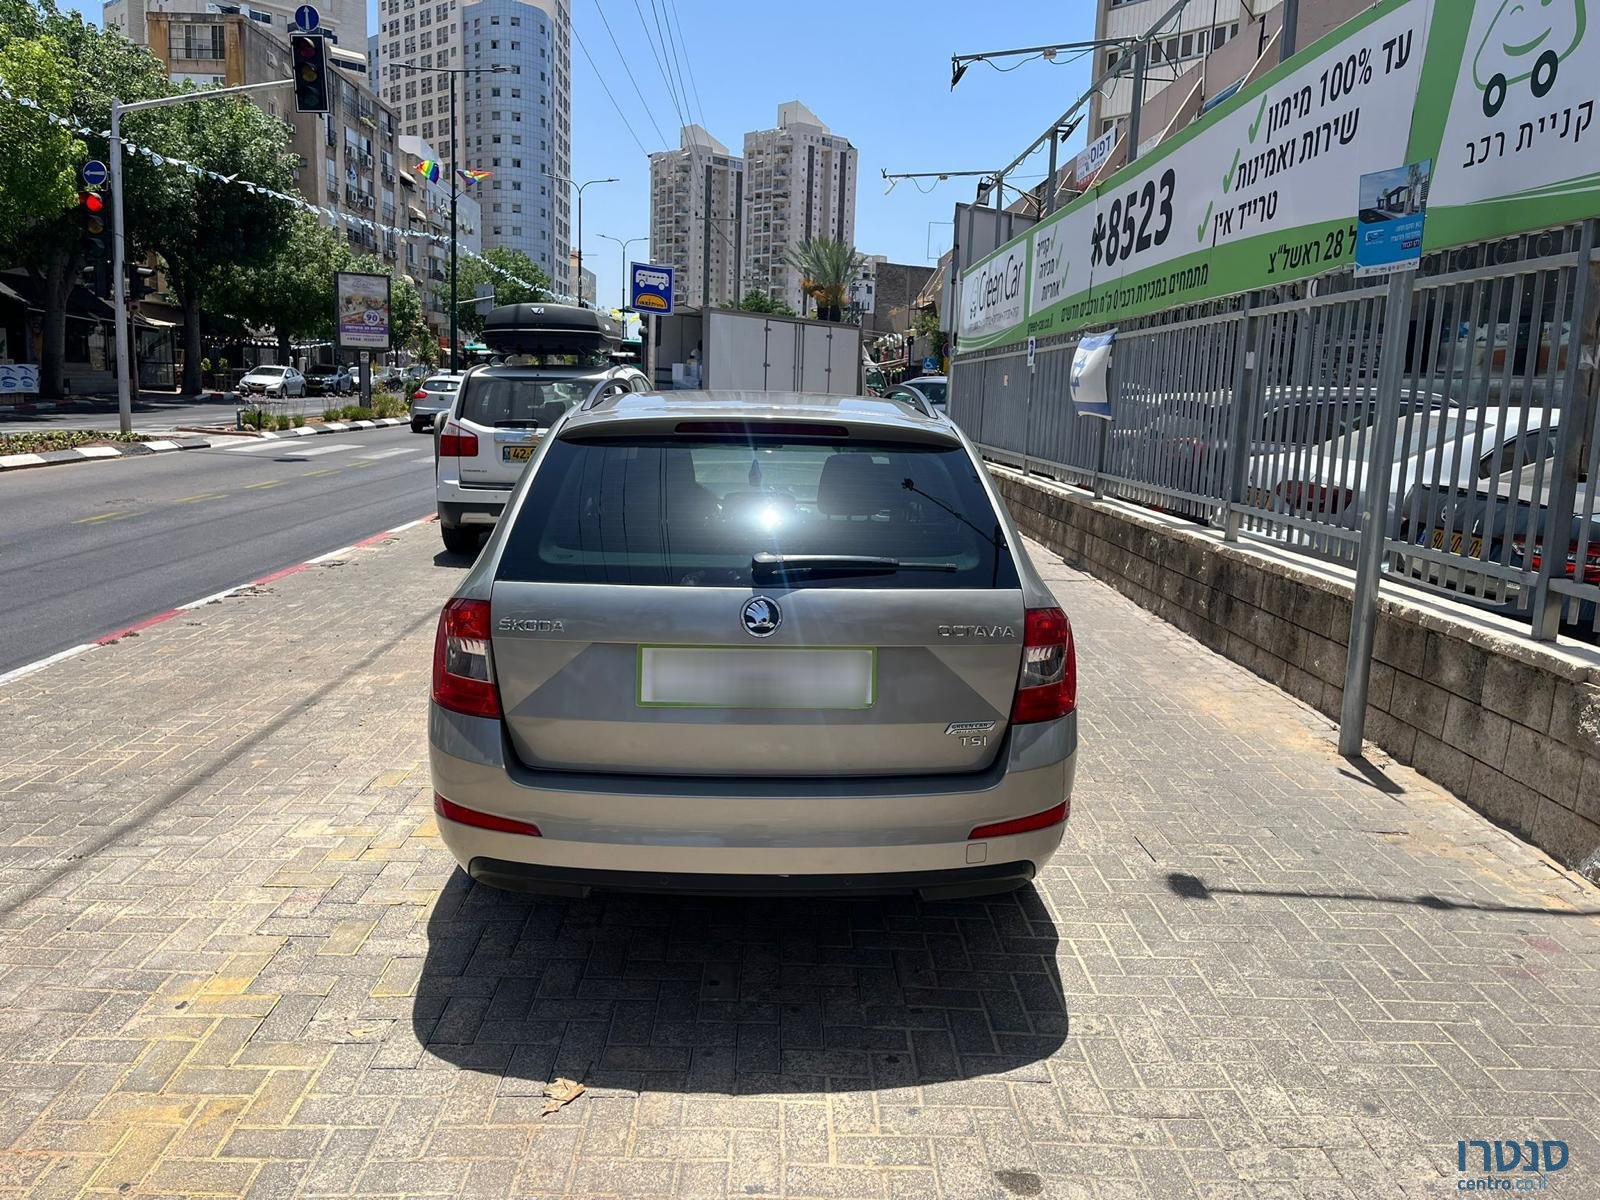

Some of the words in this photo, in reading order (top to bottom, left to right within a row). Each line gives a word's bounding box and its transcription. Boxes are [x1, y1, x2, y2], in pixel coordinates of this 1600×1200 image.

[1382, 29, 1413, 75] עד
[1320, 48, 1372, 107] 100%
[1267, 85, 1312, 144] מימון
[1516, 100, 1594, 152] קניית
[1090, 135, 1111, 163] דפוס
[1300, 107, 1360, 163] שירות
[1463, 132, 1506, 168] רכב
[1235, 138, 1296, 191] ואמינות
[1213, 207, 1234, 248] אין
[1239, 190, 1278, 230] טרייד
[1268, 241, 1320, 274] ראשל"צ
[1324, 229, 1344, 261] 28
[979, 271, 1003, 311] Green
[1005, 255, 1023, 300] Car
[1136, 277, 1166, 304] במכירת
[1169, 263, 1209, 294] מתמחים
[1113, 289, 1119, 310] 0
[1120, 287, 1135, 308] רכבי
[366, 313, 378, 321] 90
[959, 735, 988, 747] TSI
